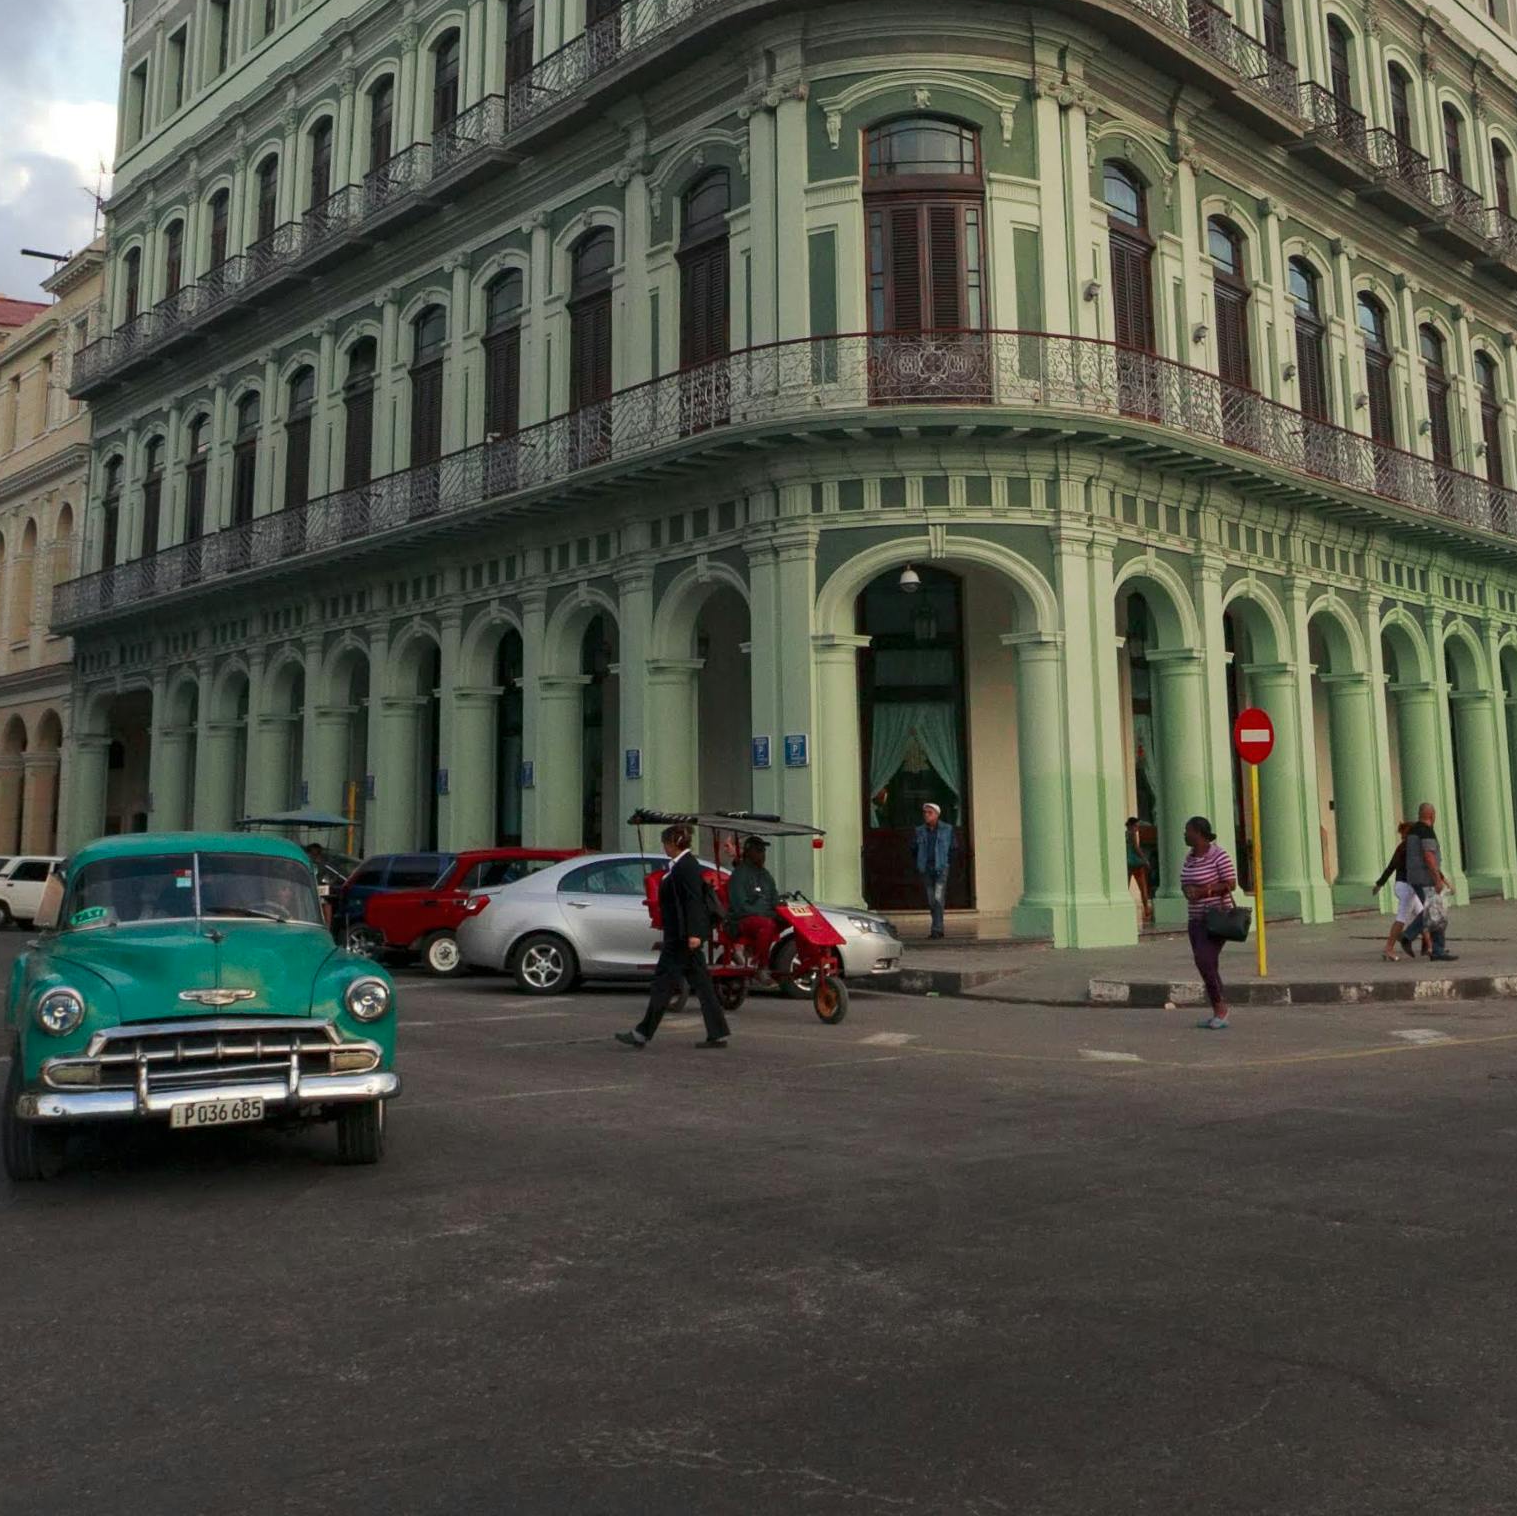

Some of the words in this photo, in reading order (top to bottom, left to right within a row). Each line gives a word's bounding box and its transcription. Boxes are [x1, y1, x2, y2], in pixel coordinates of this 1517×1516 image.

[185, 1106, 195, 1125] P
[198, 1104, 227, 1123] 036
[231, 1101, 261, 1120] 685
